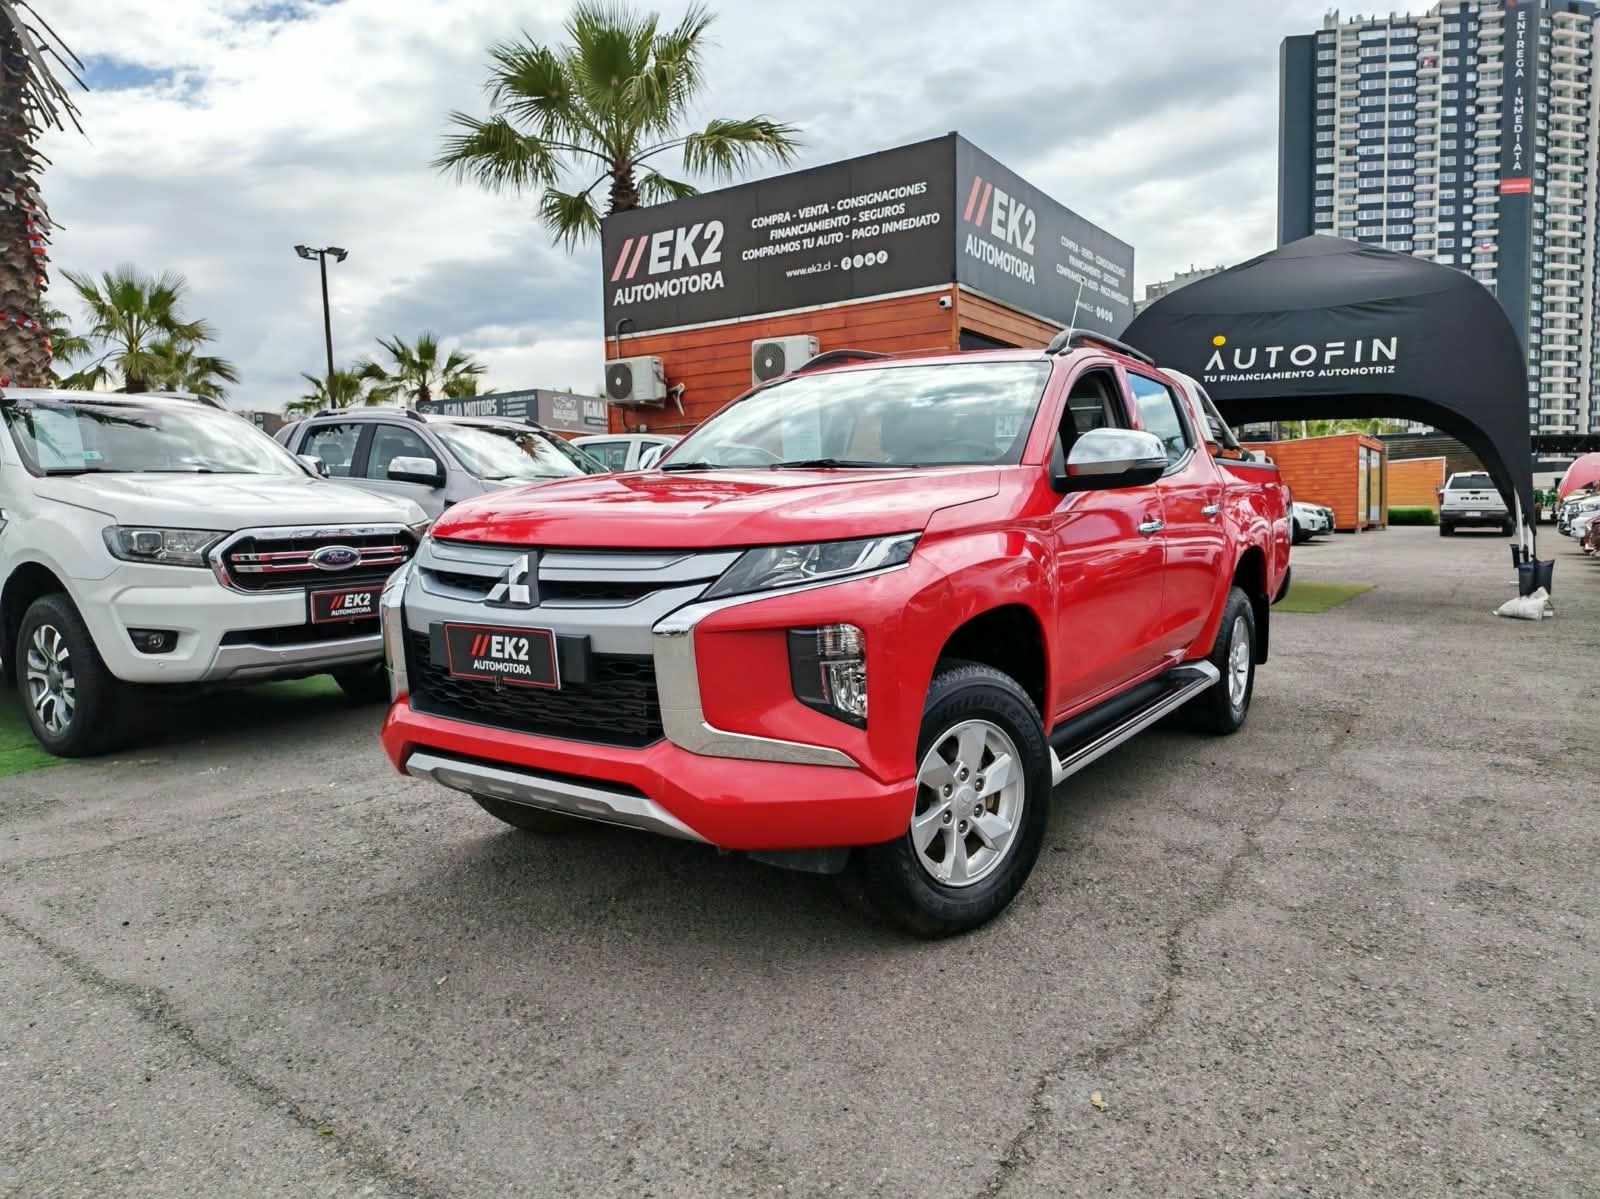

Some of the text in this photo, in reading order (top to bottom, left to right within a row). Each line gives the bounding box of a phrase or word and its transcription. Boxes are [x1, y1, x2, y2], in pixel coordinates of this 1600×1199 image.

[1515, 10, 1526, 78] ENTREGA
[1512, 87, 1525, 170] INMEDIATA
[752, 211, 791, 229] COMPRA
[798, 203, 829, 219] VENTA
[837, 181, 927, 211] CONSIGNACIONES
[770, 214, 850, 241] FINANCIAMIENTO
[858, 203, 906, 222] SEGUROS
[742, 240, 801, 261] COMPRAMOS
[802, 237, 815, 250] TU
[816, 232, 844, 247] AUTO
[852, 225, 880, 240] PAGO
[882, 212, 940, 234] INMEDIATO
[786, 260, 831, 278] www.ek2.cl
[965, 233, 1036, 285] AUTOMOTORA
[613, 270, 725, 306] AUTOMOTORA
[1205, 336, 1398, 371] AUTOFIN
[1204, 365, 1395, 382] TU FINANCIAMIENTO AUTOMOTRIZ
[463, 399, 497, 416] MOTORS
[330, 606, 371, 617] AUTOMOTORA
[473, 659, 532, 675] AUTOMOTORA
